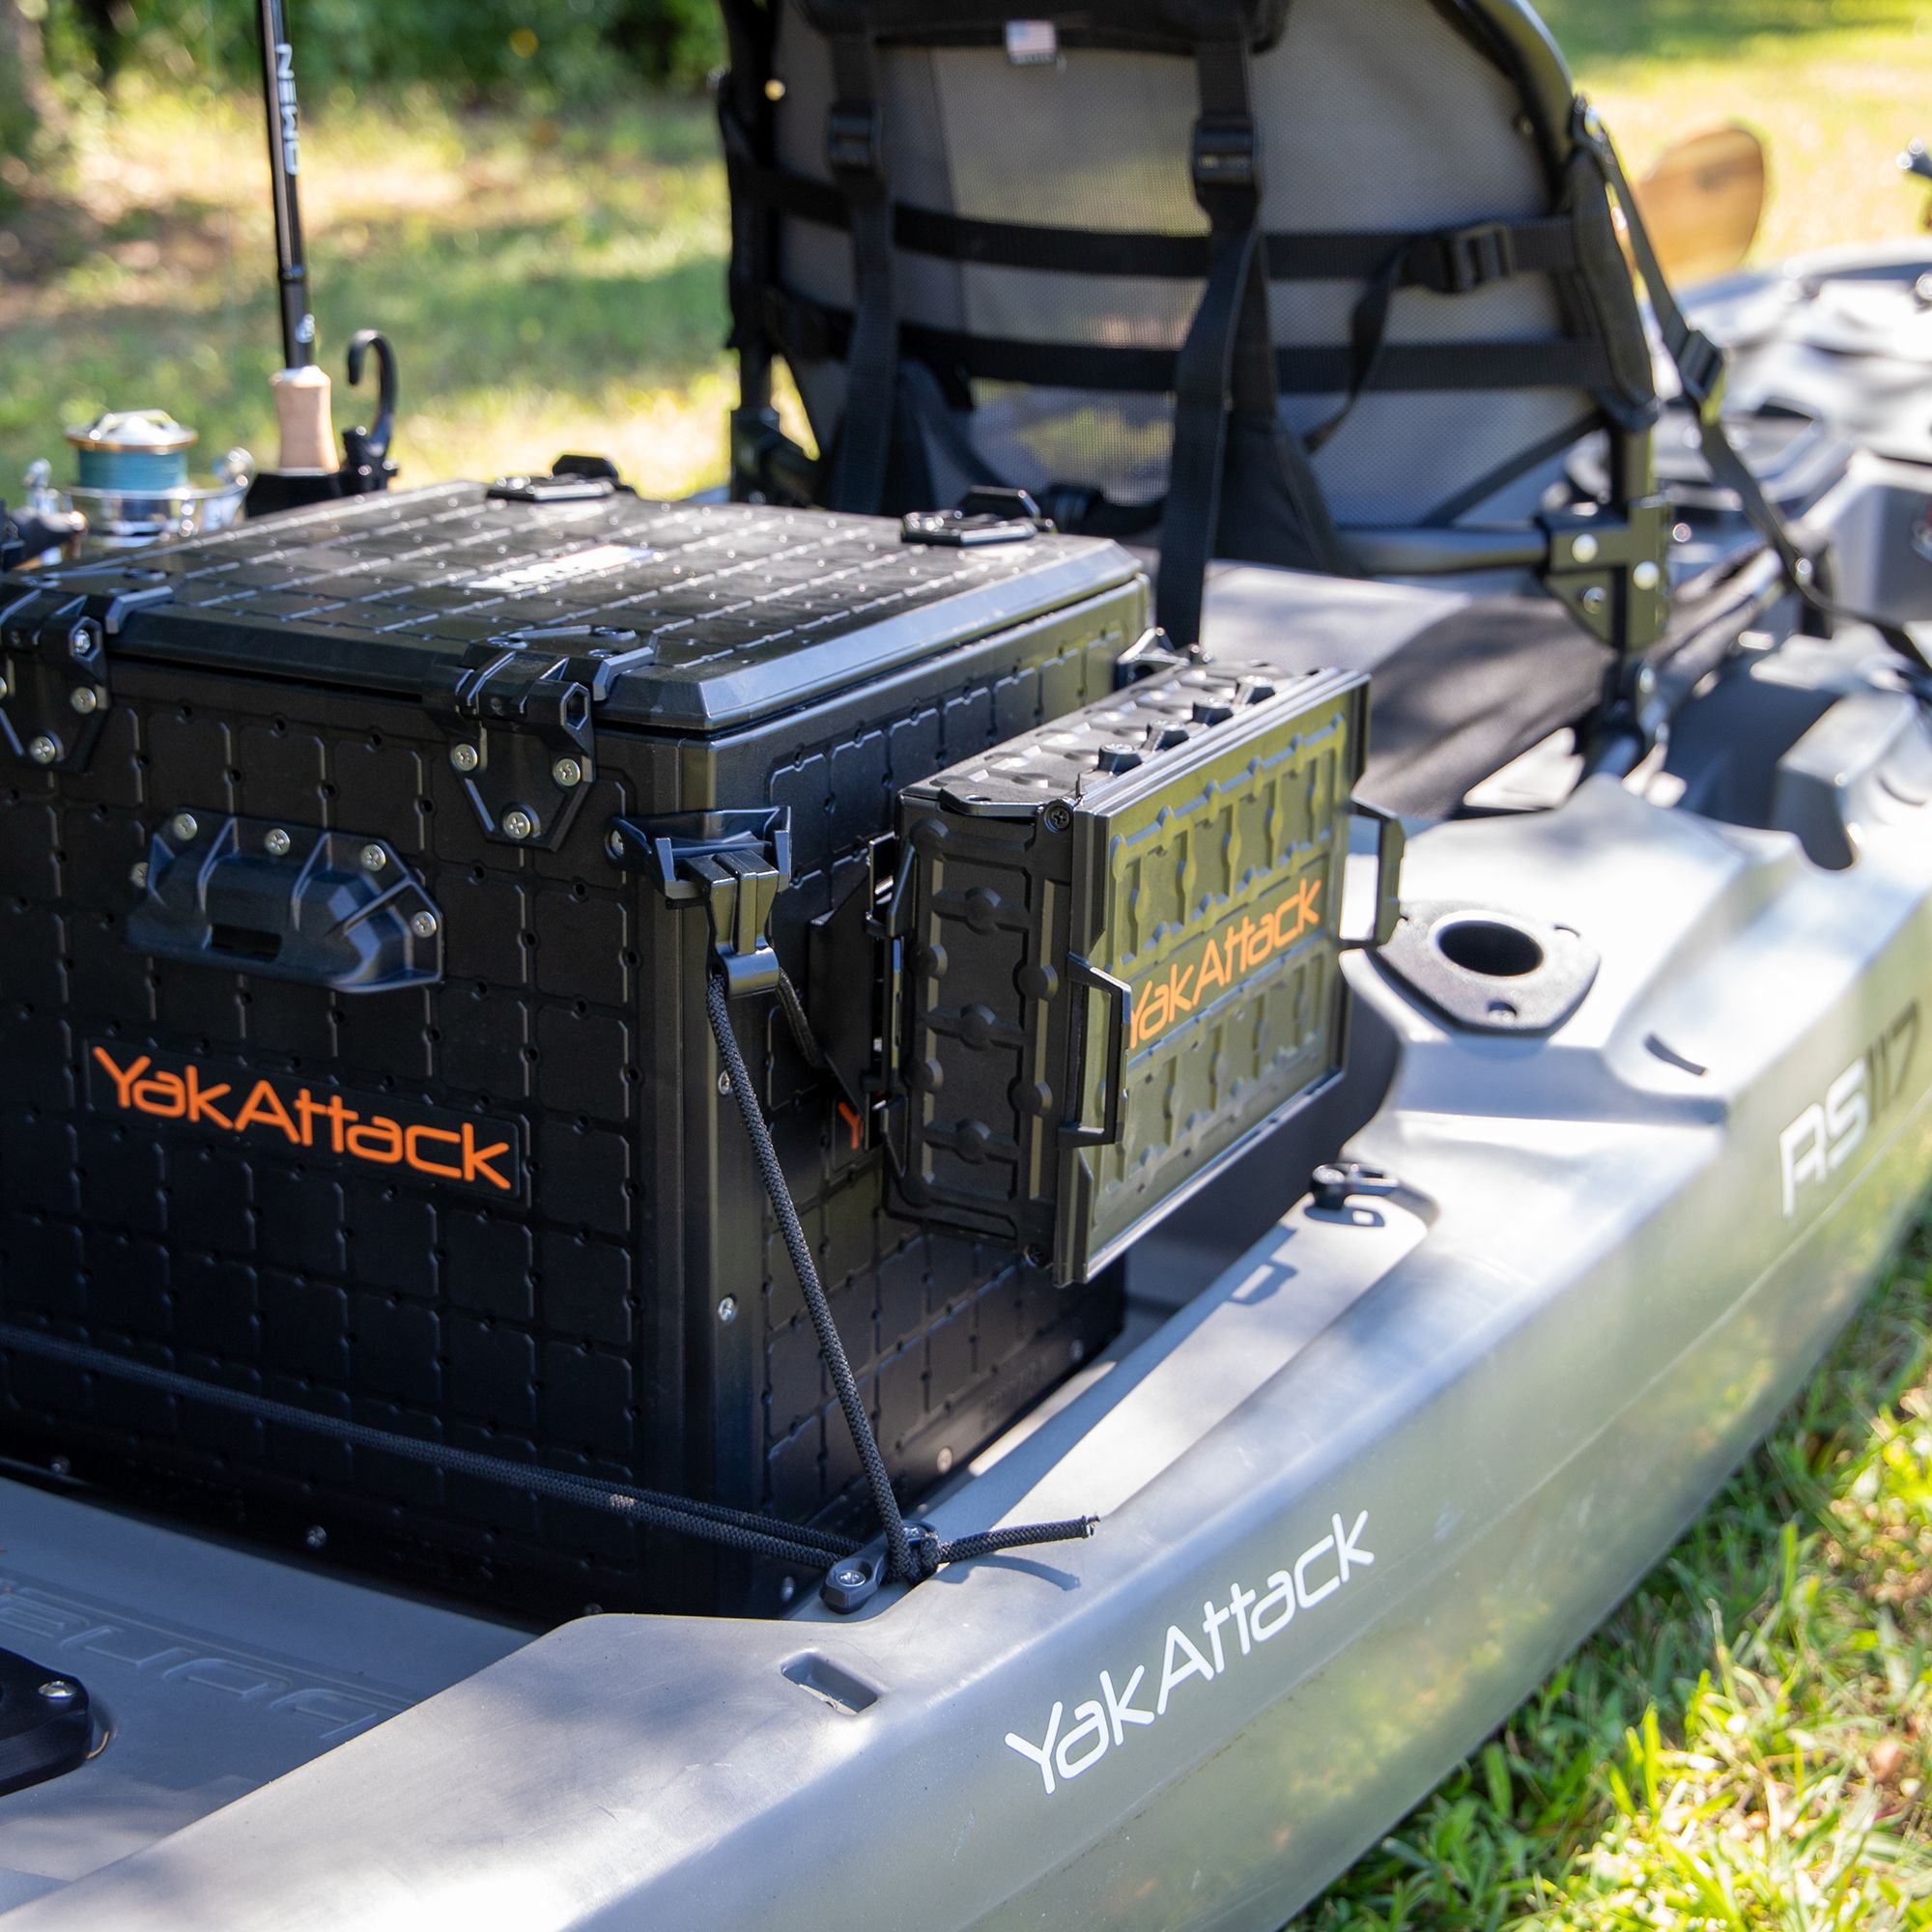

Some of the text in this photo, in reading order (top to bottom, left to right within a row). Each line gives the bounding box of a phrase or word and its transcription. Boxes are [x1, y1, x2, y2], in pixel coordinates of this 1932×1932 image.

[1130, 877, 1321, 1049] YakAttack
[93, 1046, 511, 1190] YakAttack
[1005, 1510, 1375, 1794] YakAttack
